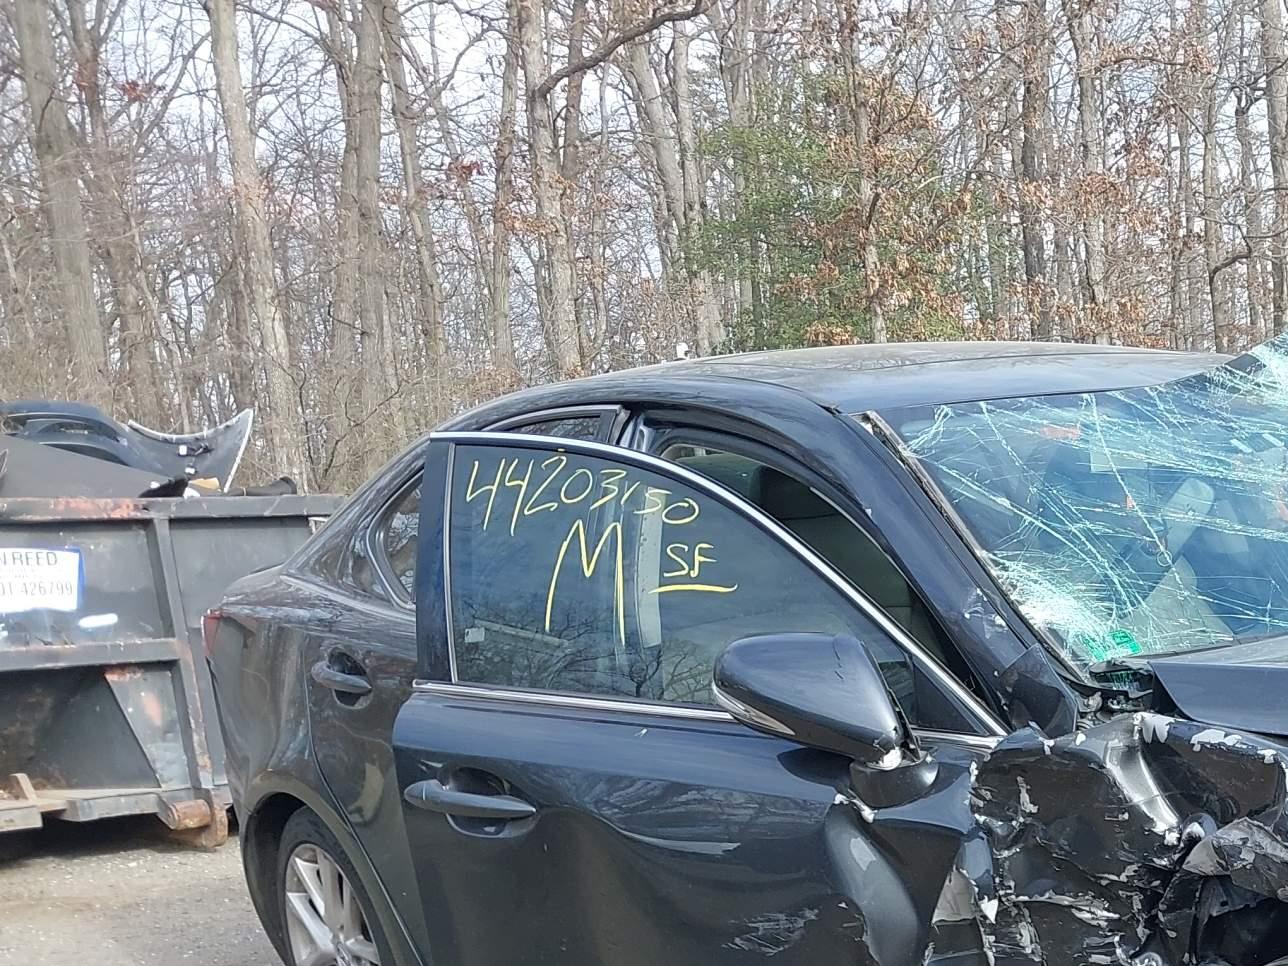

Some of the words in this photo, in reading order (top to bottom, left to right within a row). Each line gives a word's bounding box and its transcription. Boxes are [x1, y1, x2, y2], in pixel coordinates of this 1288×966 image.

[465, 455, 700, 537] 44203150
[544, 519, 626, 647] M
[662, 543, 717, 578] SF
